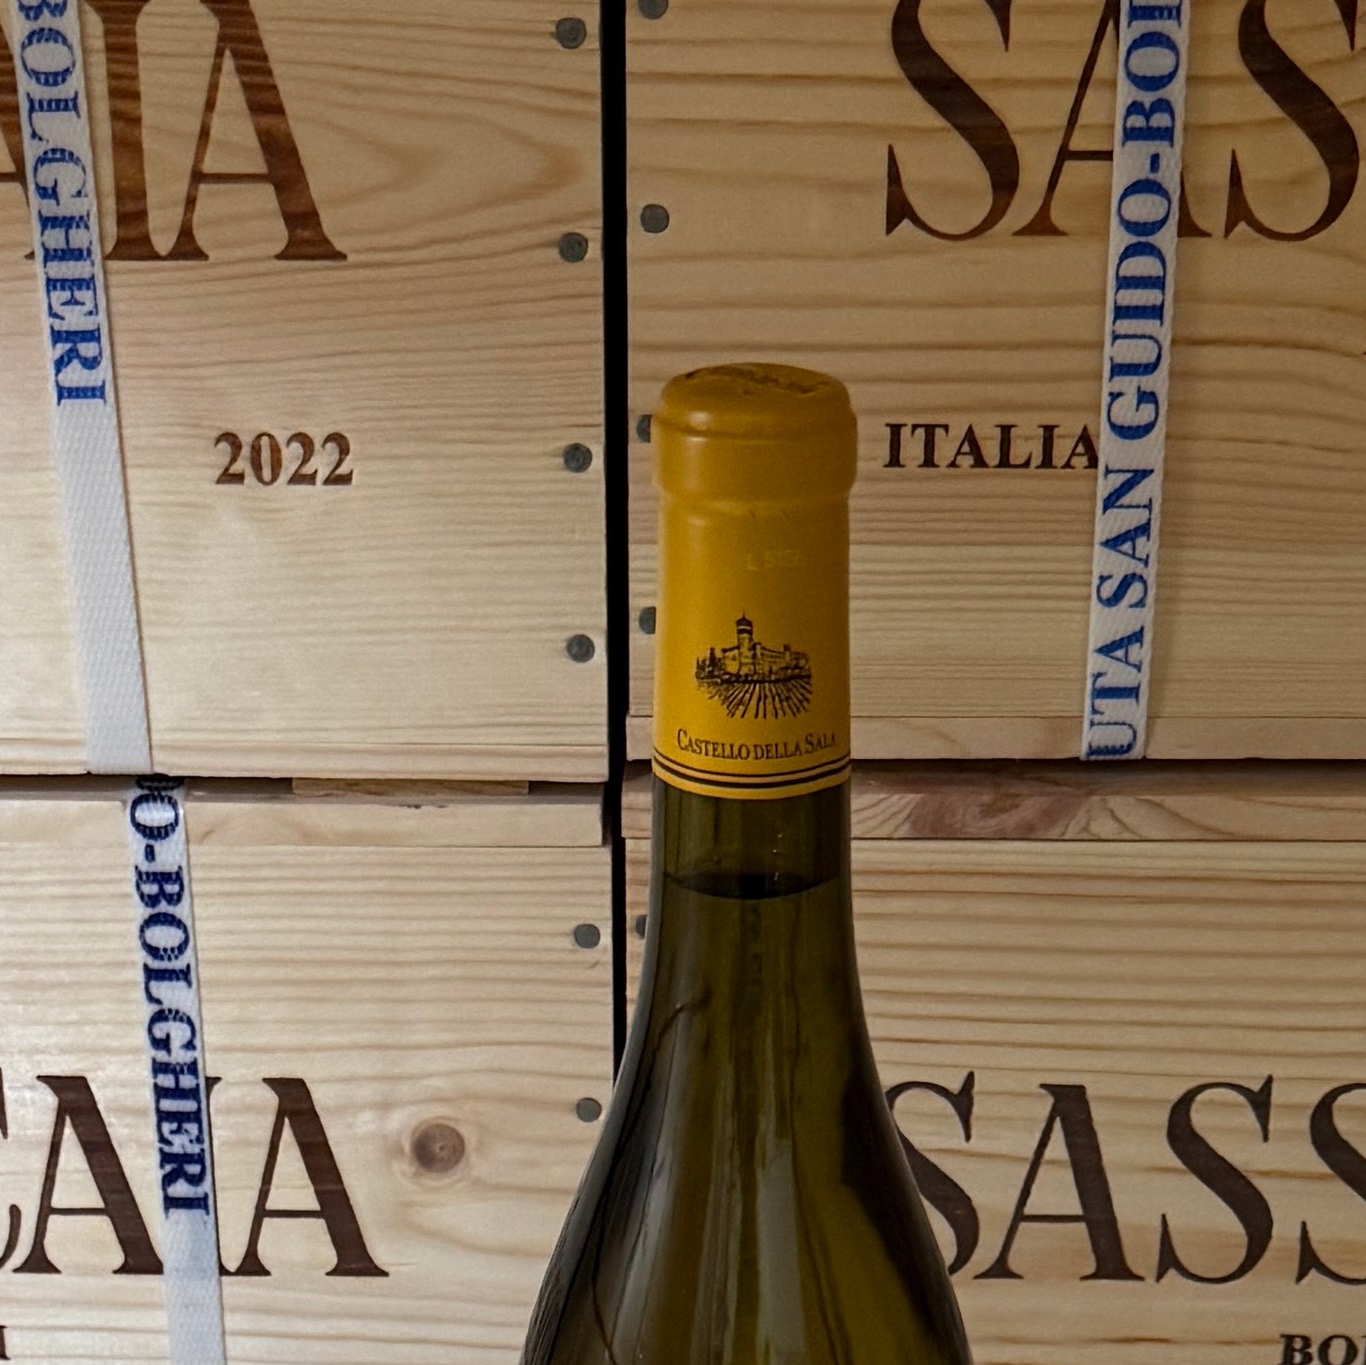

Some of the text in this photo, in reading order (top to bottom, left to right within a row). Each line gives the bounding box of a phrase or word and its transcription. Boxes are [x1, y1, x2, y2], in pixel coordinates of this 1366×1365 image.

[213, 431, 354, 486] 2022
[882, 422, 1099, 470] ITALIA
[1095, 468, 1155, 610] SAN
